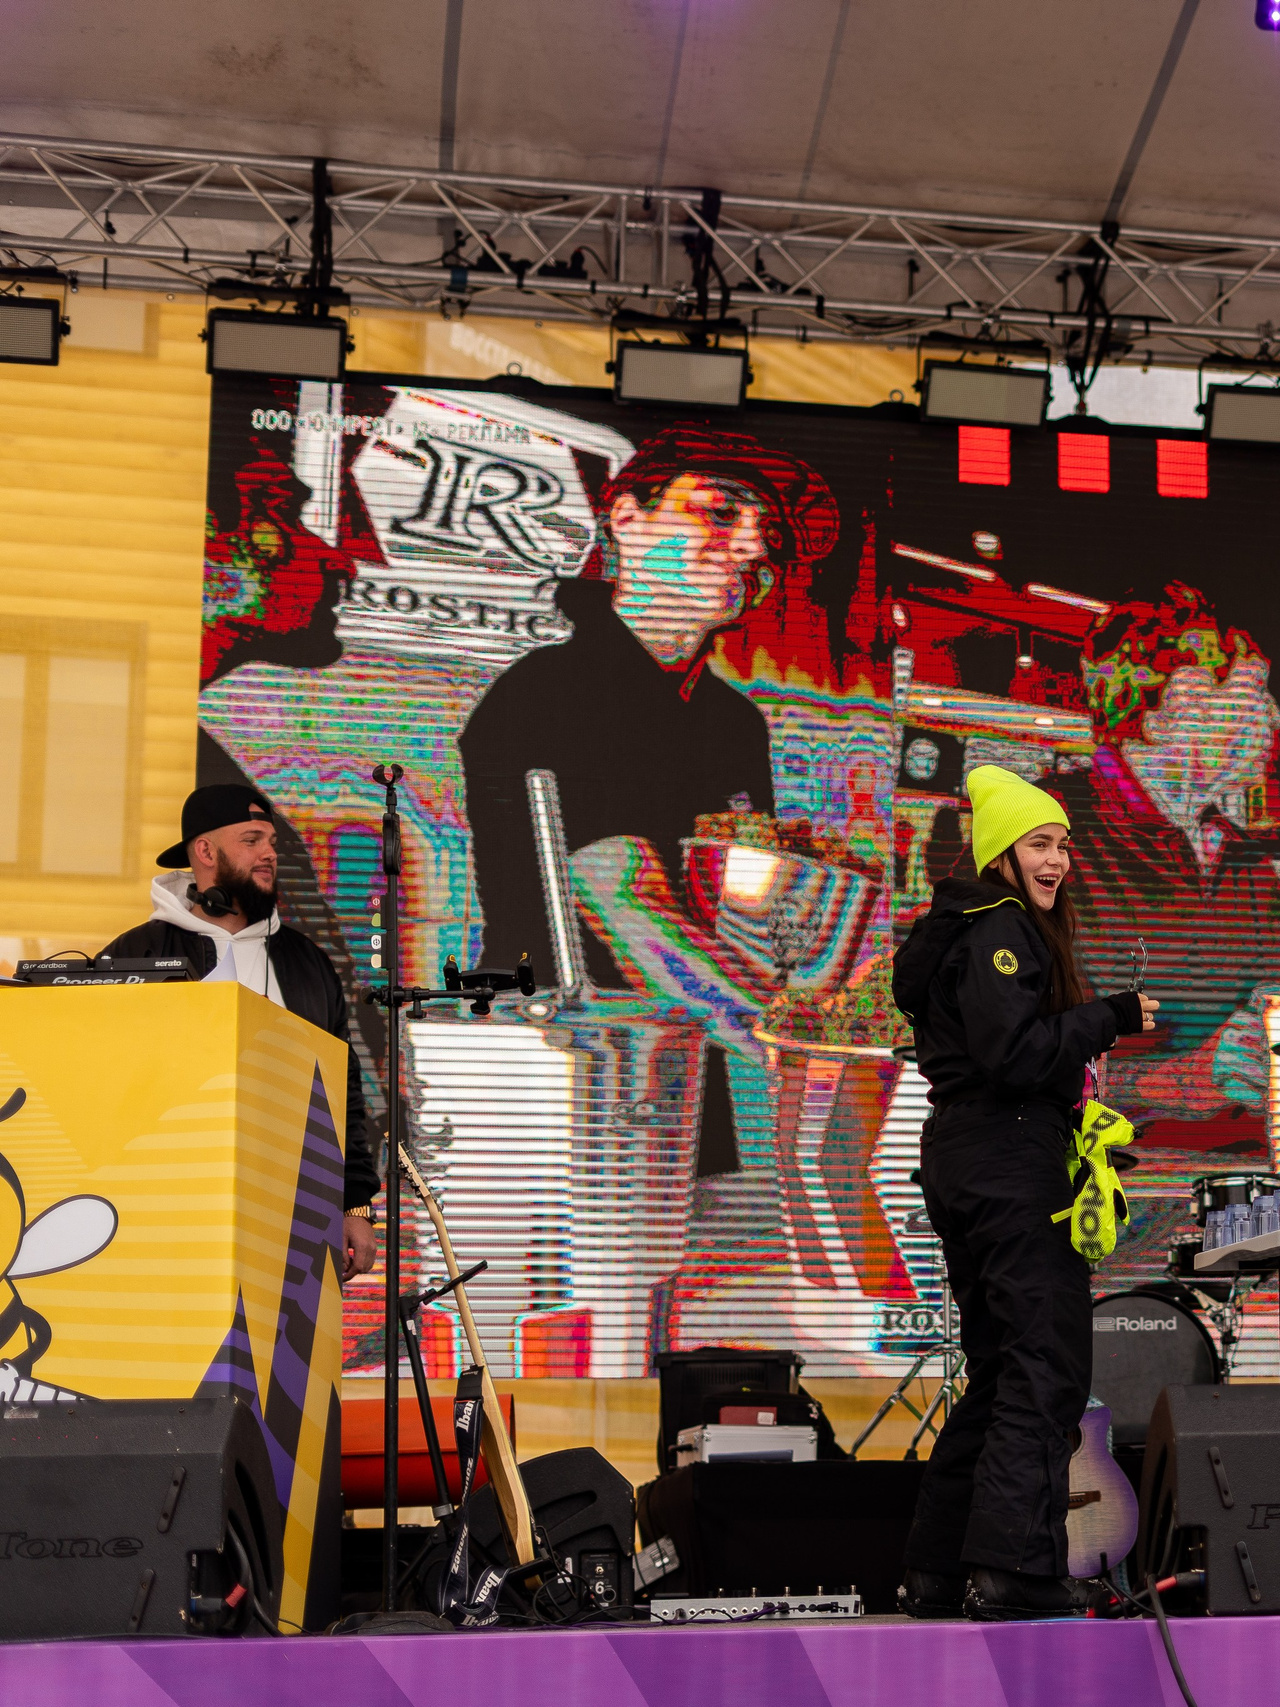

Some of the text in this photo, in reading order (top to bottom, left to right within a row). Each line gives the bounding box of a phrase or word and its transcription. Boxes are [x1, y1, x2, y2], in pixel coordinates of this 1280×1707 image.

[154, 959, 183, 968] serato
[1115, 1316, 1178, 1331] Roland
[595, 1581, 605, 1594] 6
